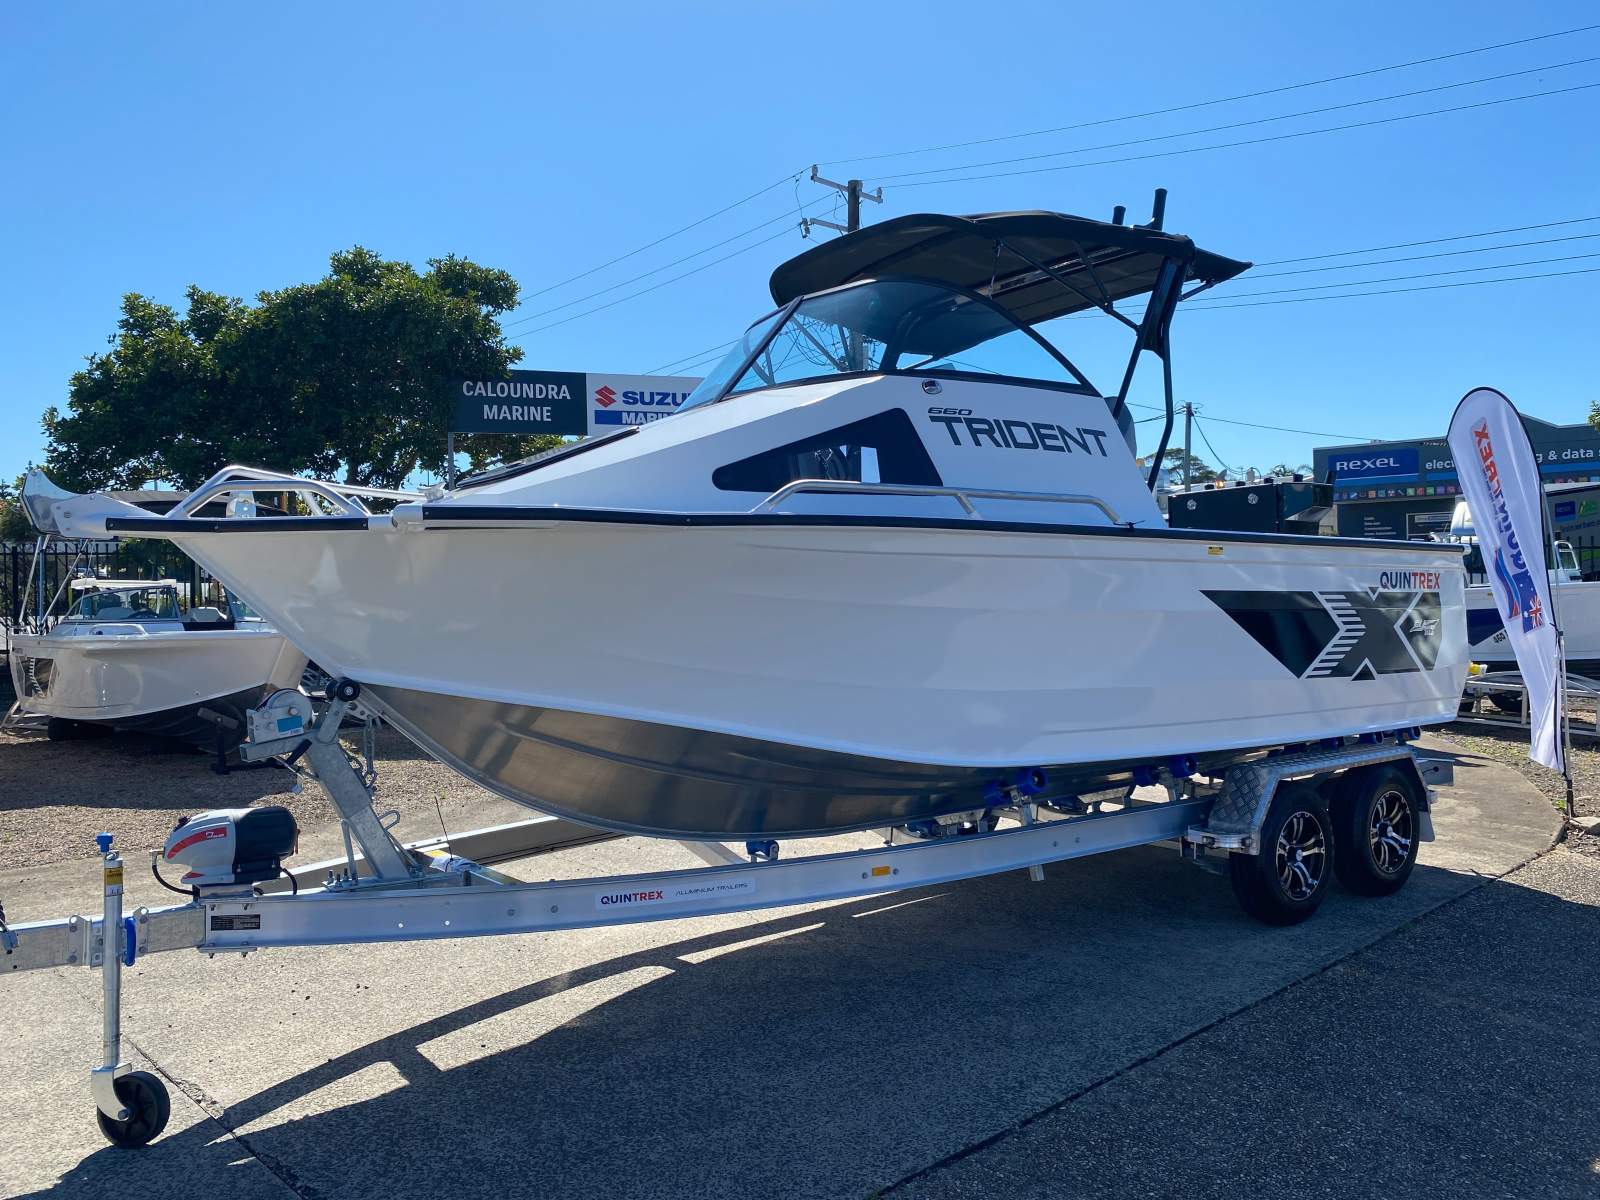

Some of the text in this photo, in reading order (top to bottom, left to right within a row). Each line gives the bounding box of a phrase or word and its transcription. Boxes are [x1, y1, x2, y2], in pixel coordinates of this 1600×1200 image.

[462, 380, 571, 400] CALOUNDRA
[622, 390, 692, 407] SUZU
[483, 404, 552, 422] MARINE
[927, 406, 973, 416] 660
[928, 415, 1108, 458] TRIDENT
[1548, 450, 1558, 461] &
[1561, 448, 1594, 460] data
[1380, 571, 1441, 590] QUINTREX
[600, 890, 664, 905] QUINTREX
